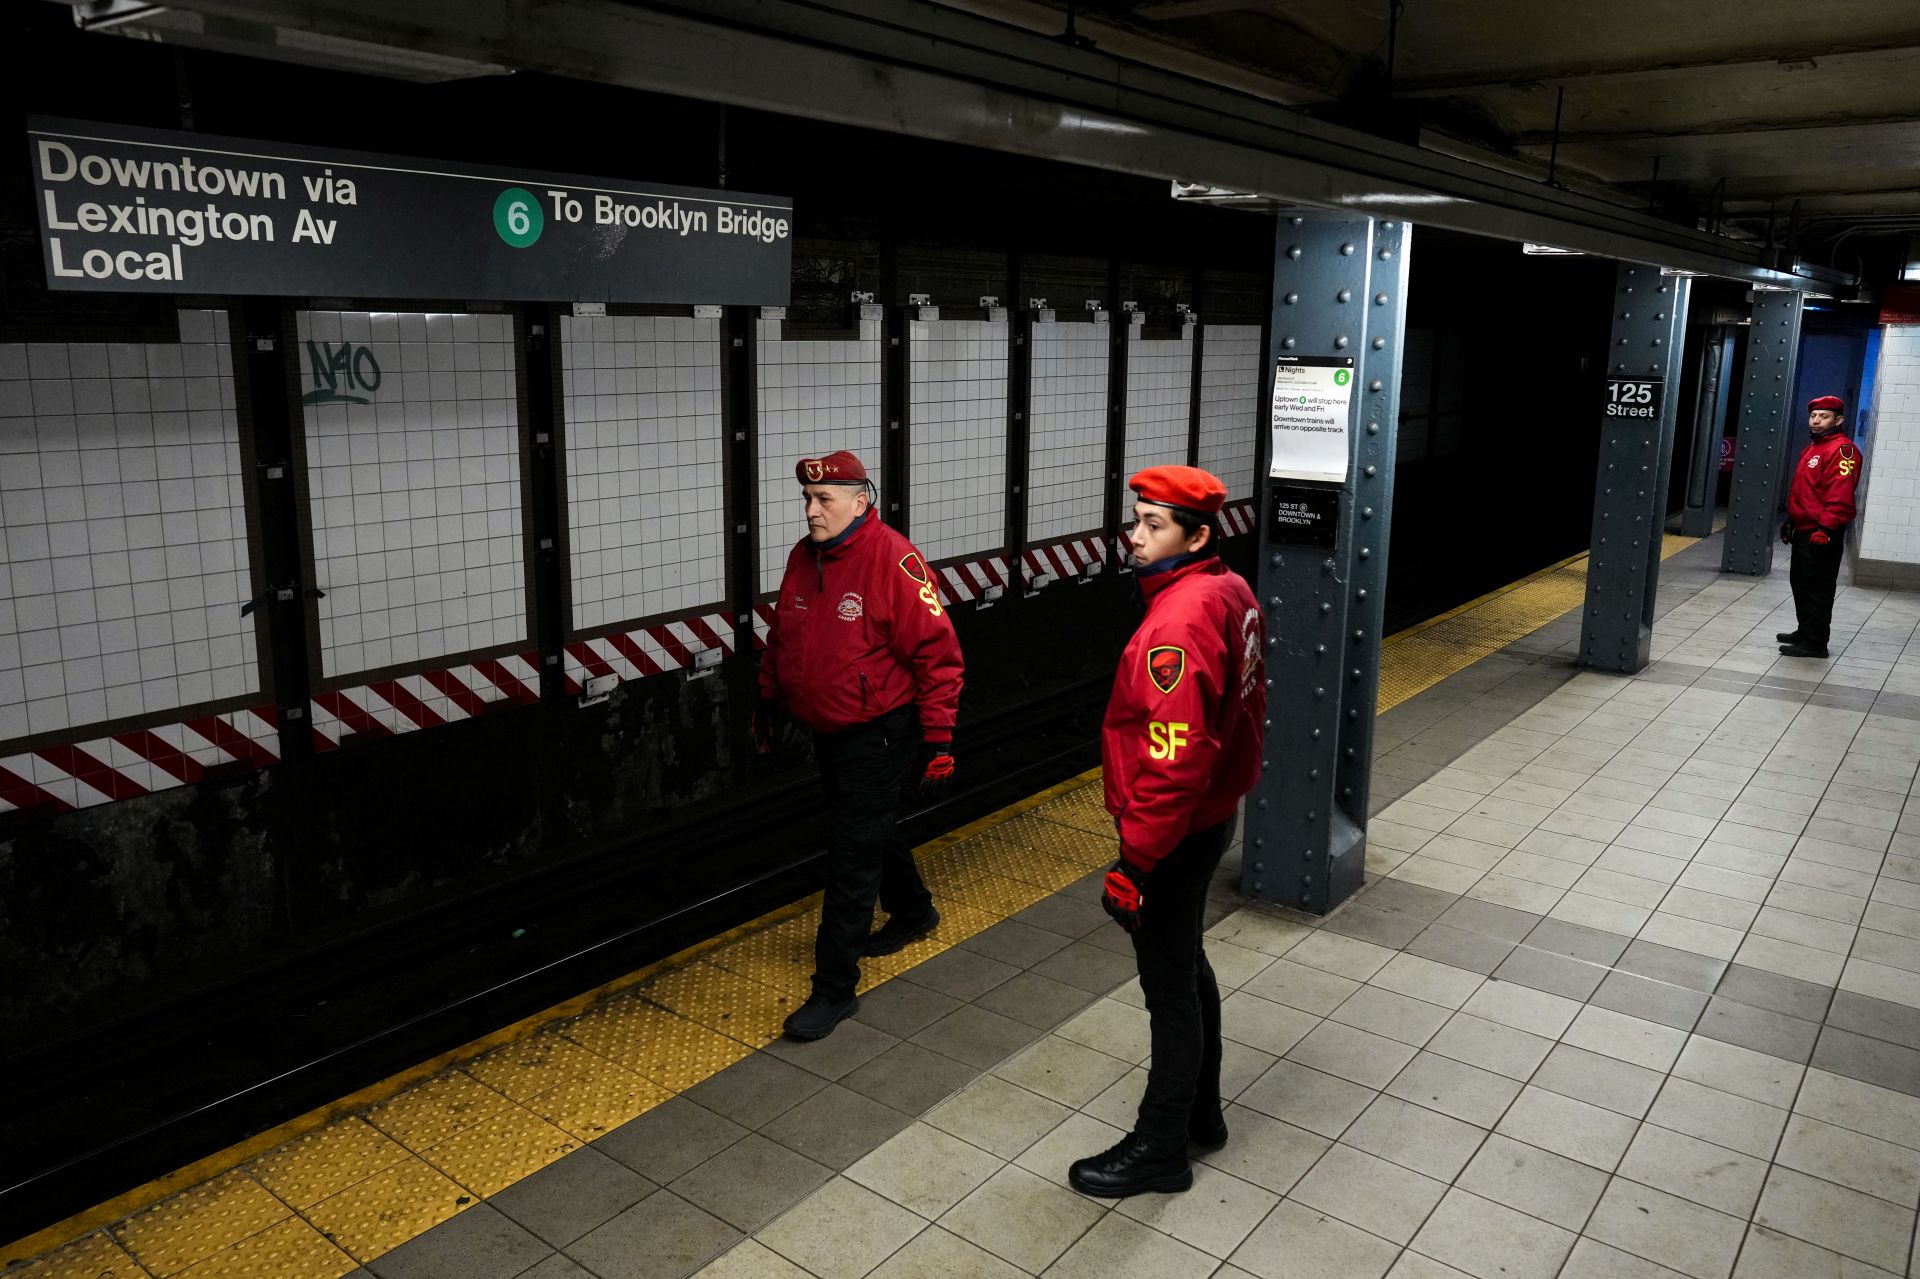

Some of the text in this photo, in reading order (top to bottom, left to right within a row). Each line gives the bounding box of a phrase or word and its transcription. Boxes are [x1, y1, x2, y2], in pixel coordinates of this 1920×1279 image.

[38, 140, 357, 206] Downtown via
[44, 189, 337, 247] Lexington Av
[507, 190, 789, 243] 6 To Brooklyn Bridge
[50, 237, 184, 281] Local
[1285, 366, 1345, 383] Nights 6
[1274, 396, 1298, 404] Uptown
[1608, 383, 1652, 404] 125
[1274, 404, 1288, 412] early
[1606, 403, 1655, 418] Street
[1274, 415, 1306, 423] Downtown
[1306, 417, 1324, 425] trains
[1300, 425, 1327, 433] opposite
[1839, 459, 1855, 476] SF
[1278, 510, 1316, 519] DOWNTOWN
[1278, 516, 1311, 525] BROOKLYN
[1148, 721, 1189, 761] SF
